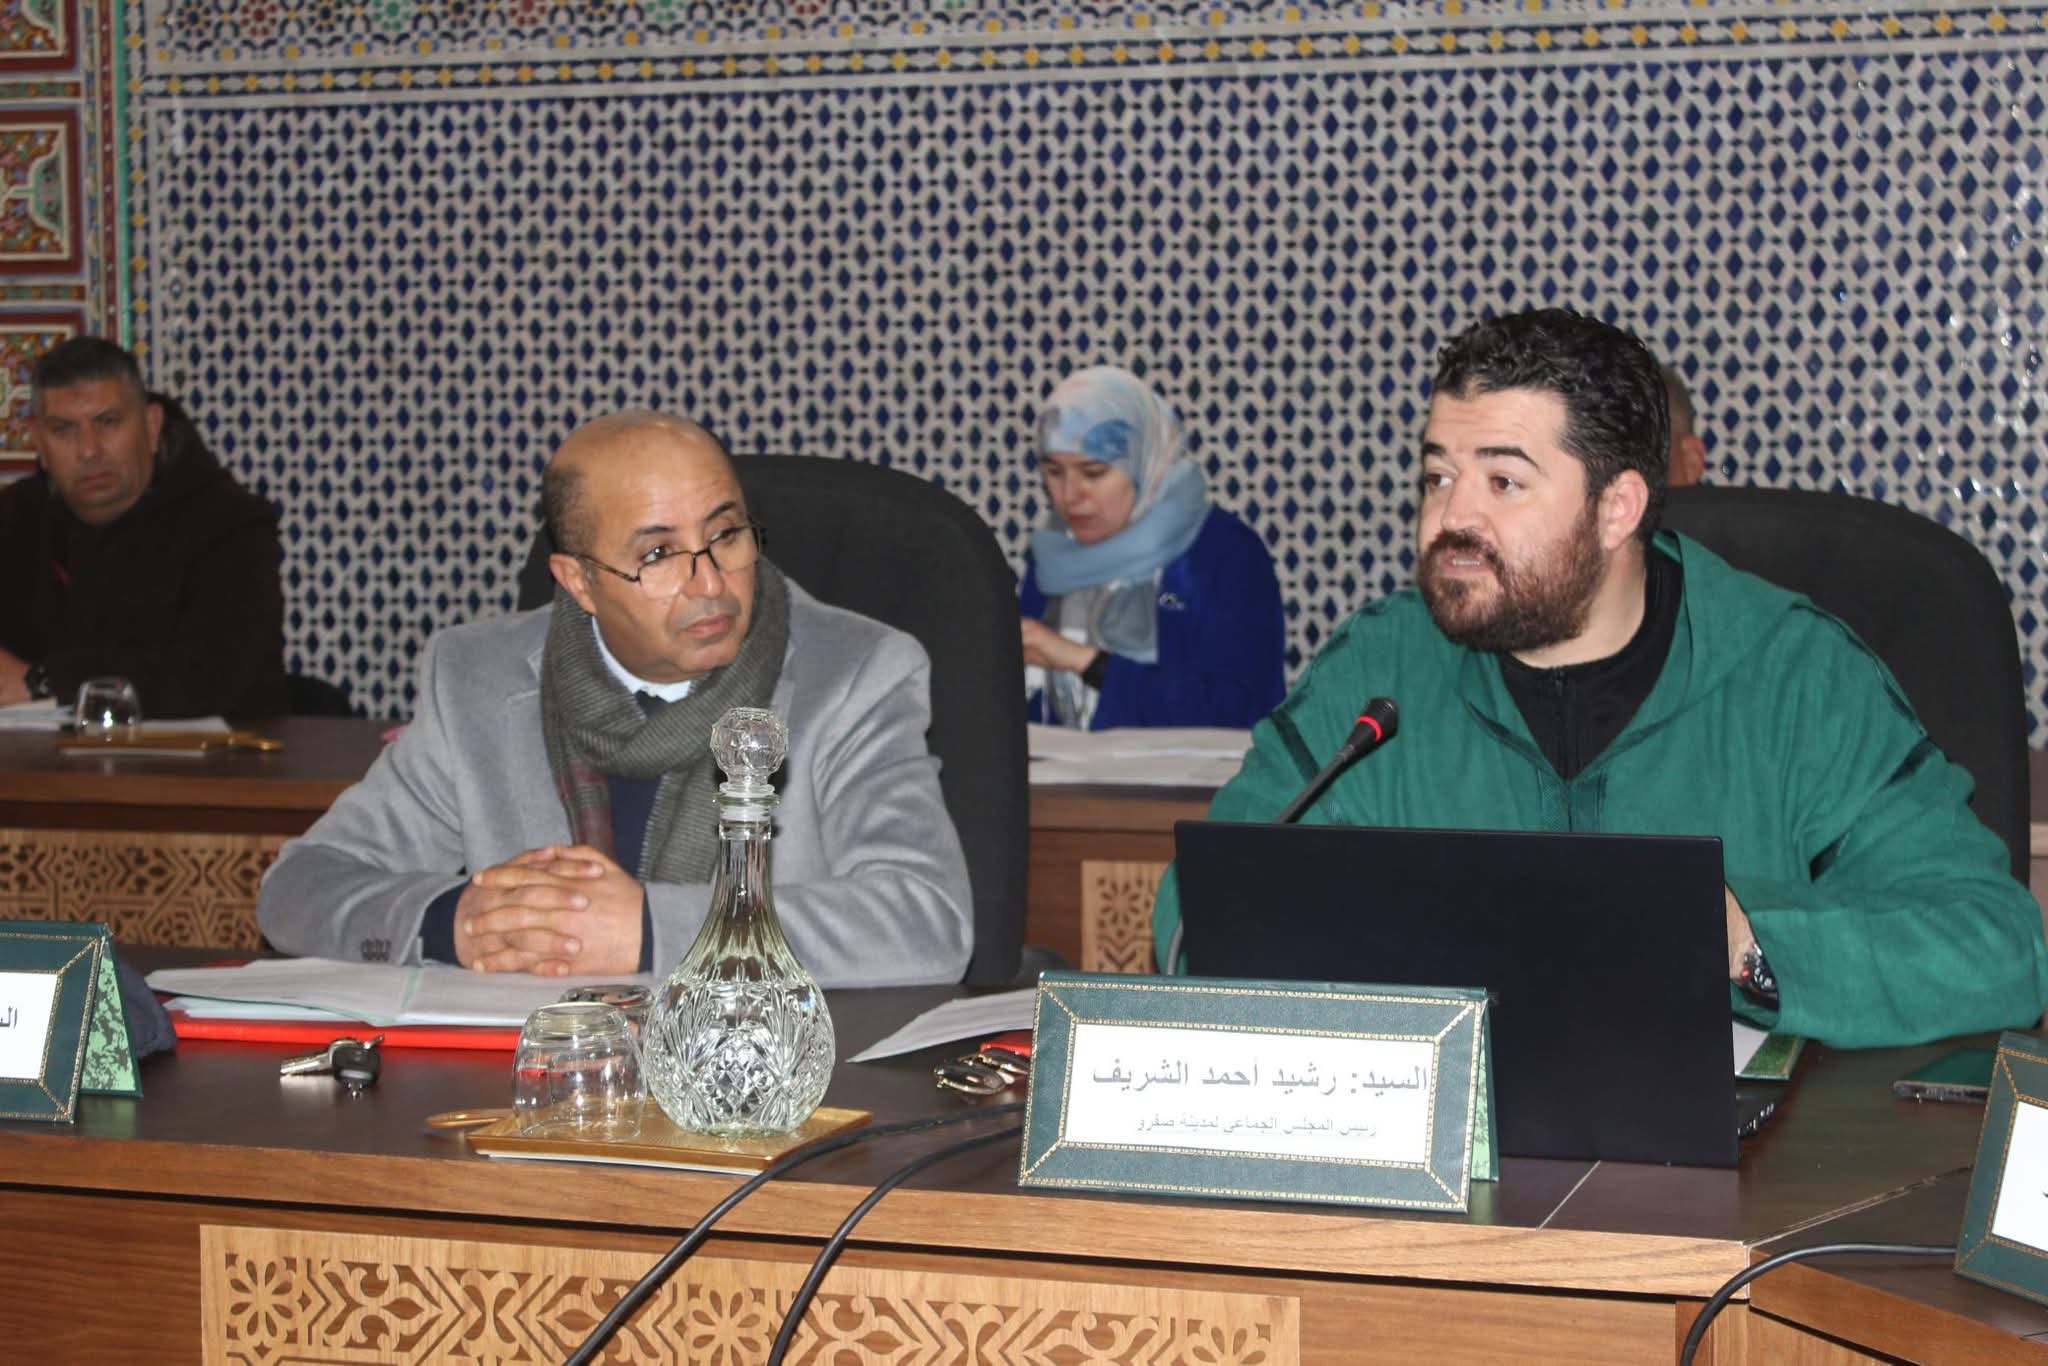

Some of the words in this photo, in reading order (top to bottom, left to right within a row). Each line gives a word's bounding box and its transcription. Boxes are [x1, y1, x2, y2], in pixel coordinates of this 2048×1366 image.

[1092, 1058, 1189, 1092] الشريف
[1271, 1061, 1337, 1095] رشيد
[1350, 1065, 1428, 1097] السيد:
[1136, 1113, 1175, 1132] صفرو
[1282, 1116, 1334, 1135] المجلس
